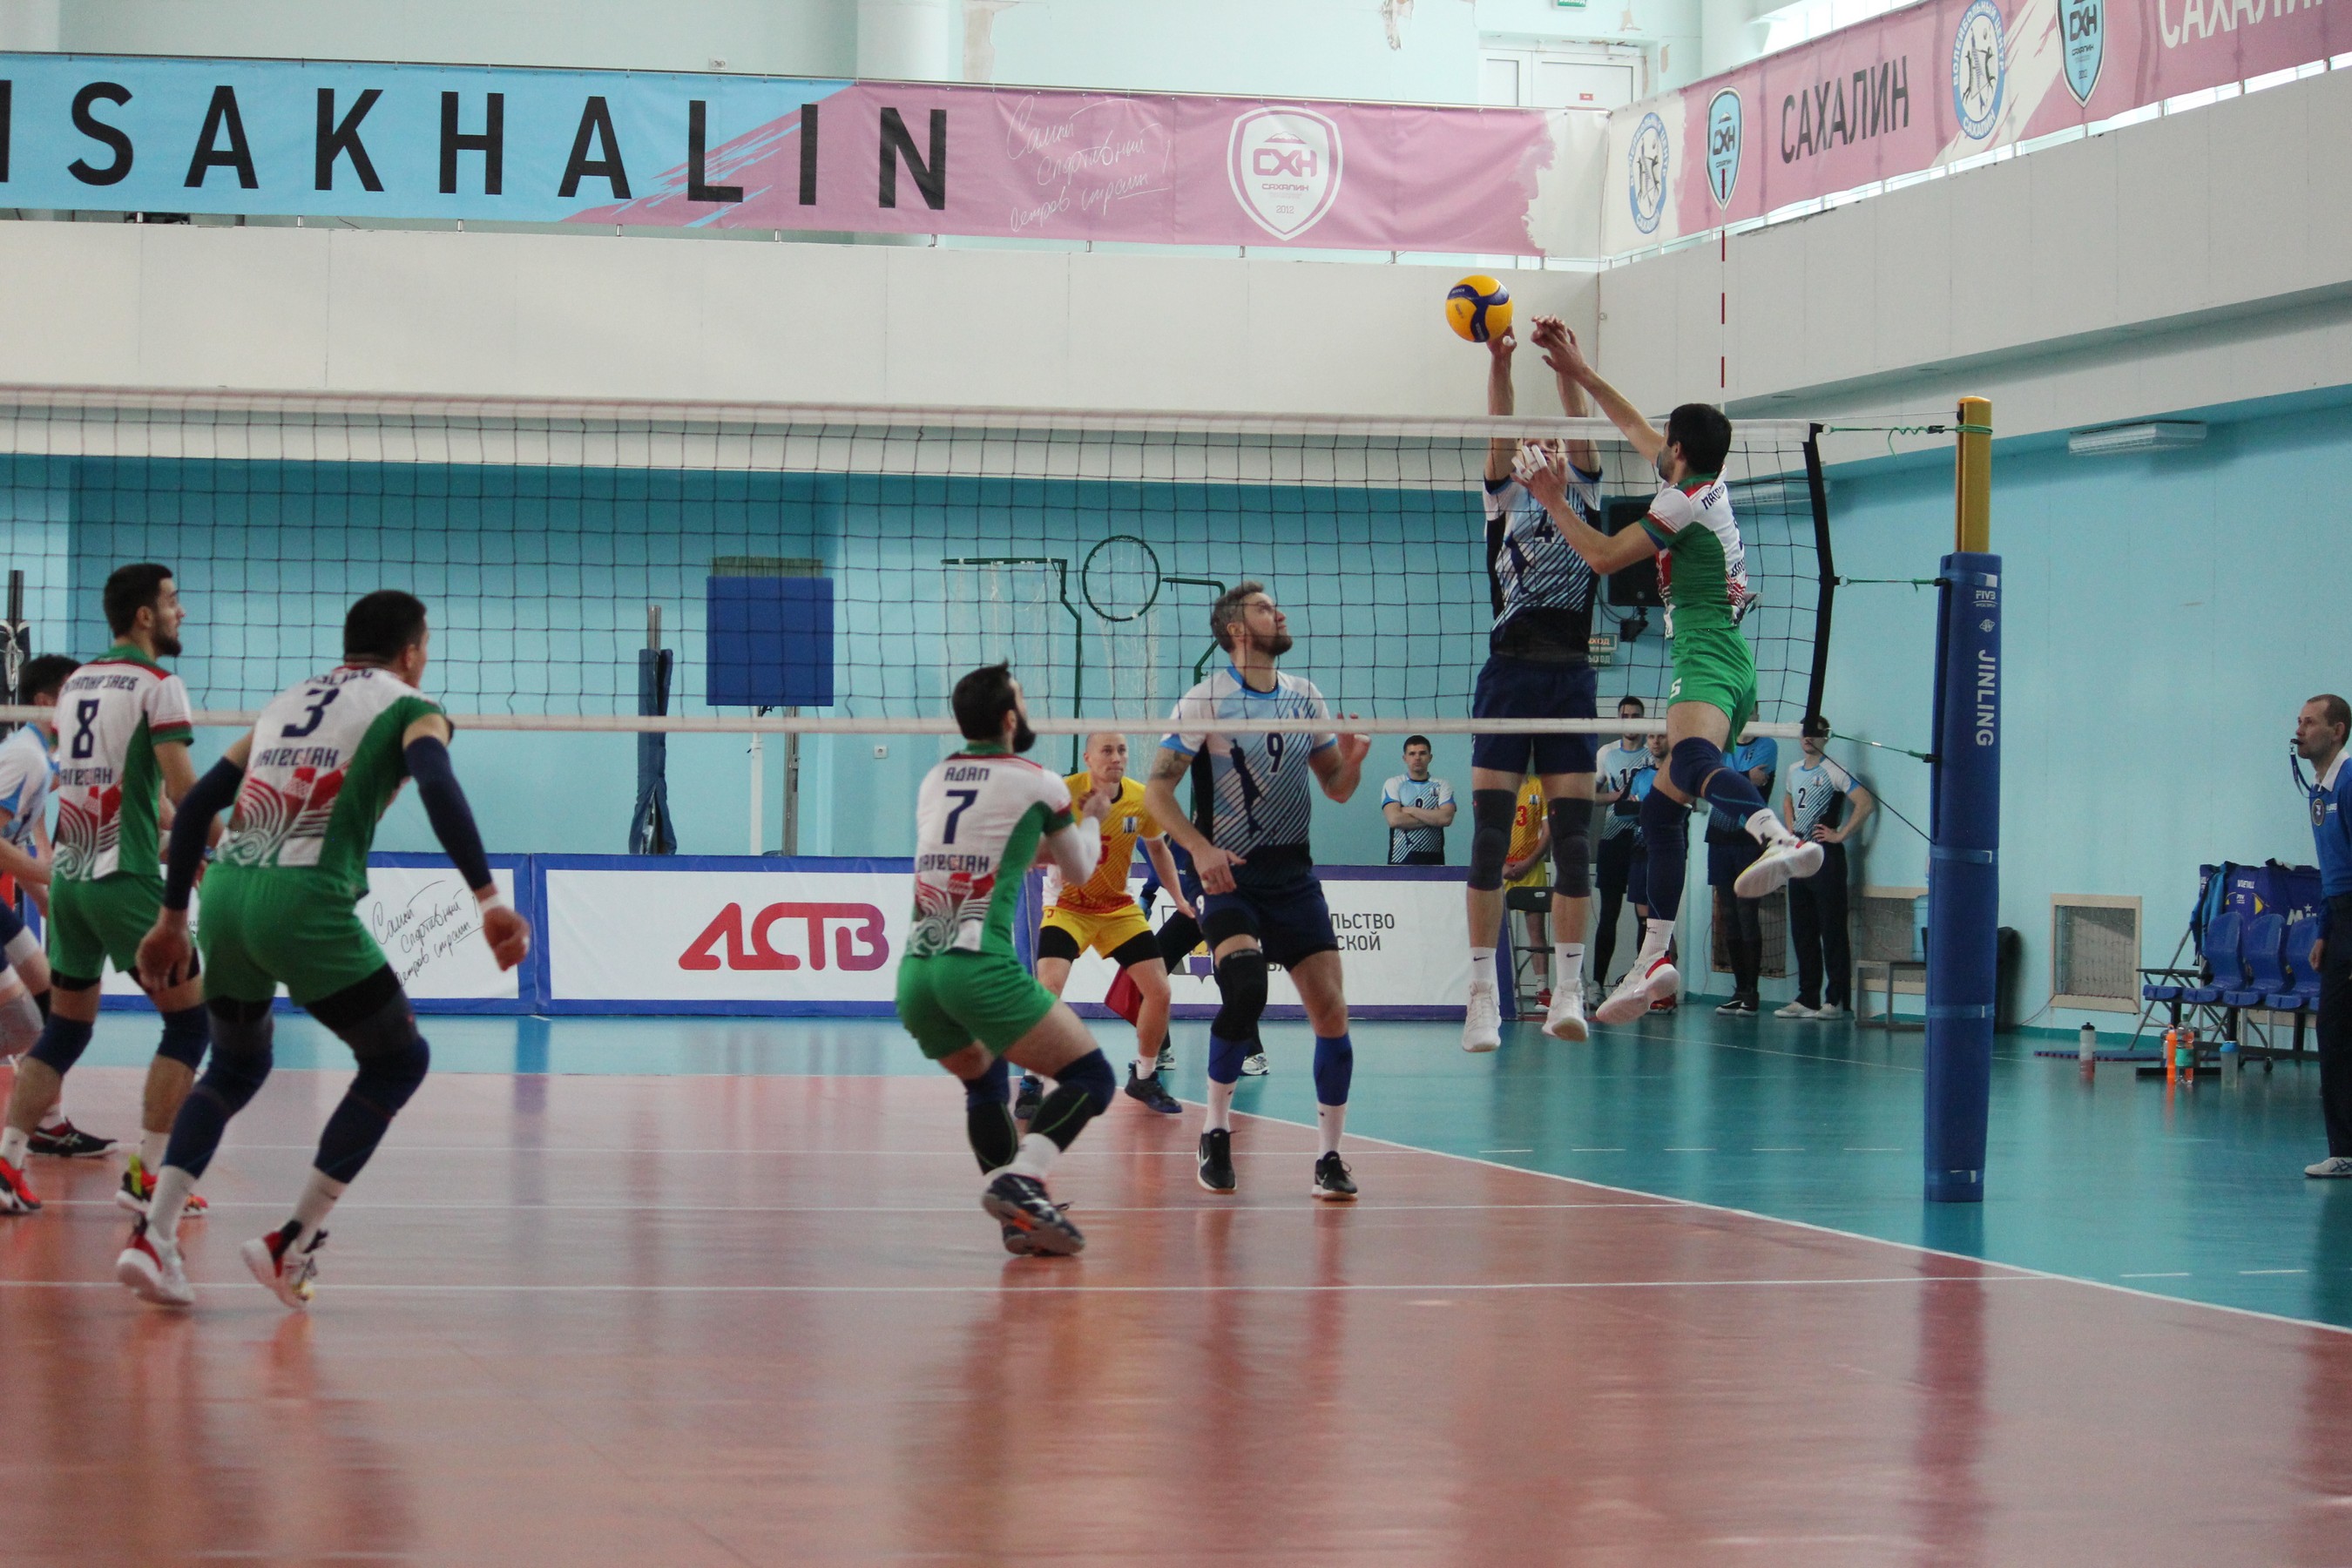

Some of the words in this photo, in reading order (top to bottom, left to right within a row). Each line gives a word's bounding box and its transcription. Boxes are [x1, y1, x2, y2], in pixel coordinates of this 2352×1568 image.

[1781, 55, 1909, 165] САХАЛИН
[1261, 183, 1309, 192] САХАЛИН
[1275, 205, 1294, 214] 2012
[1976, 649, 1996, 747] JINLING
[280, 688, 340, 737] 3
[71, 699, 99, 759] 8
[1267, 733, 1284, 773] 9
[1798, 787, 1806, 808] 2
[943, 789, 978, 844] 7
[1517, 805, 1527, 827] 3
[1196, 895, 1205, 915] 9
[1330, 913, 1395, 929] ЛЬСТВО
[1336, 931, 1381, 951] СКОЙ
